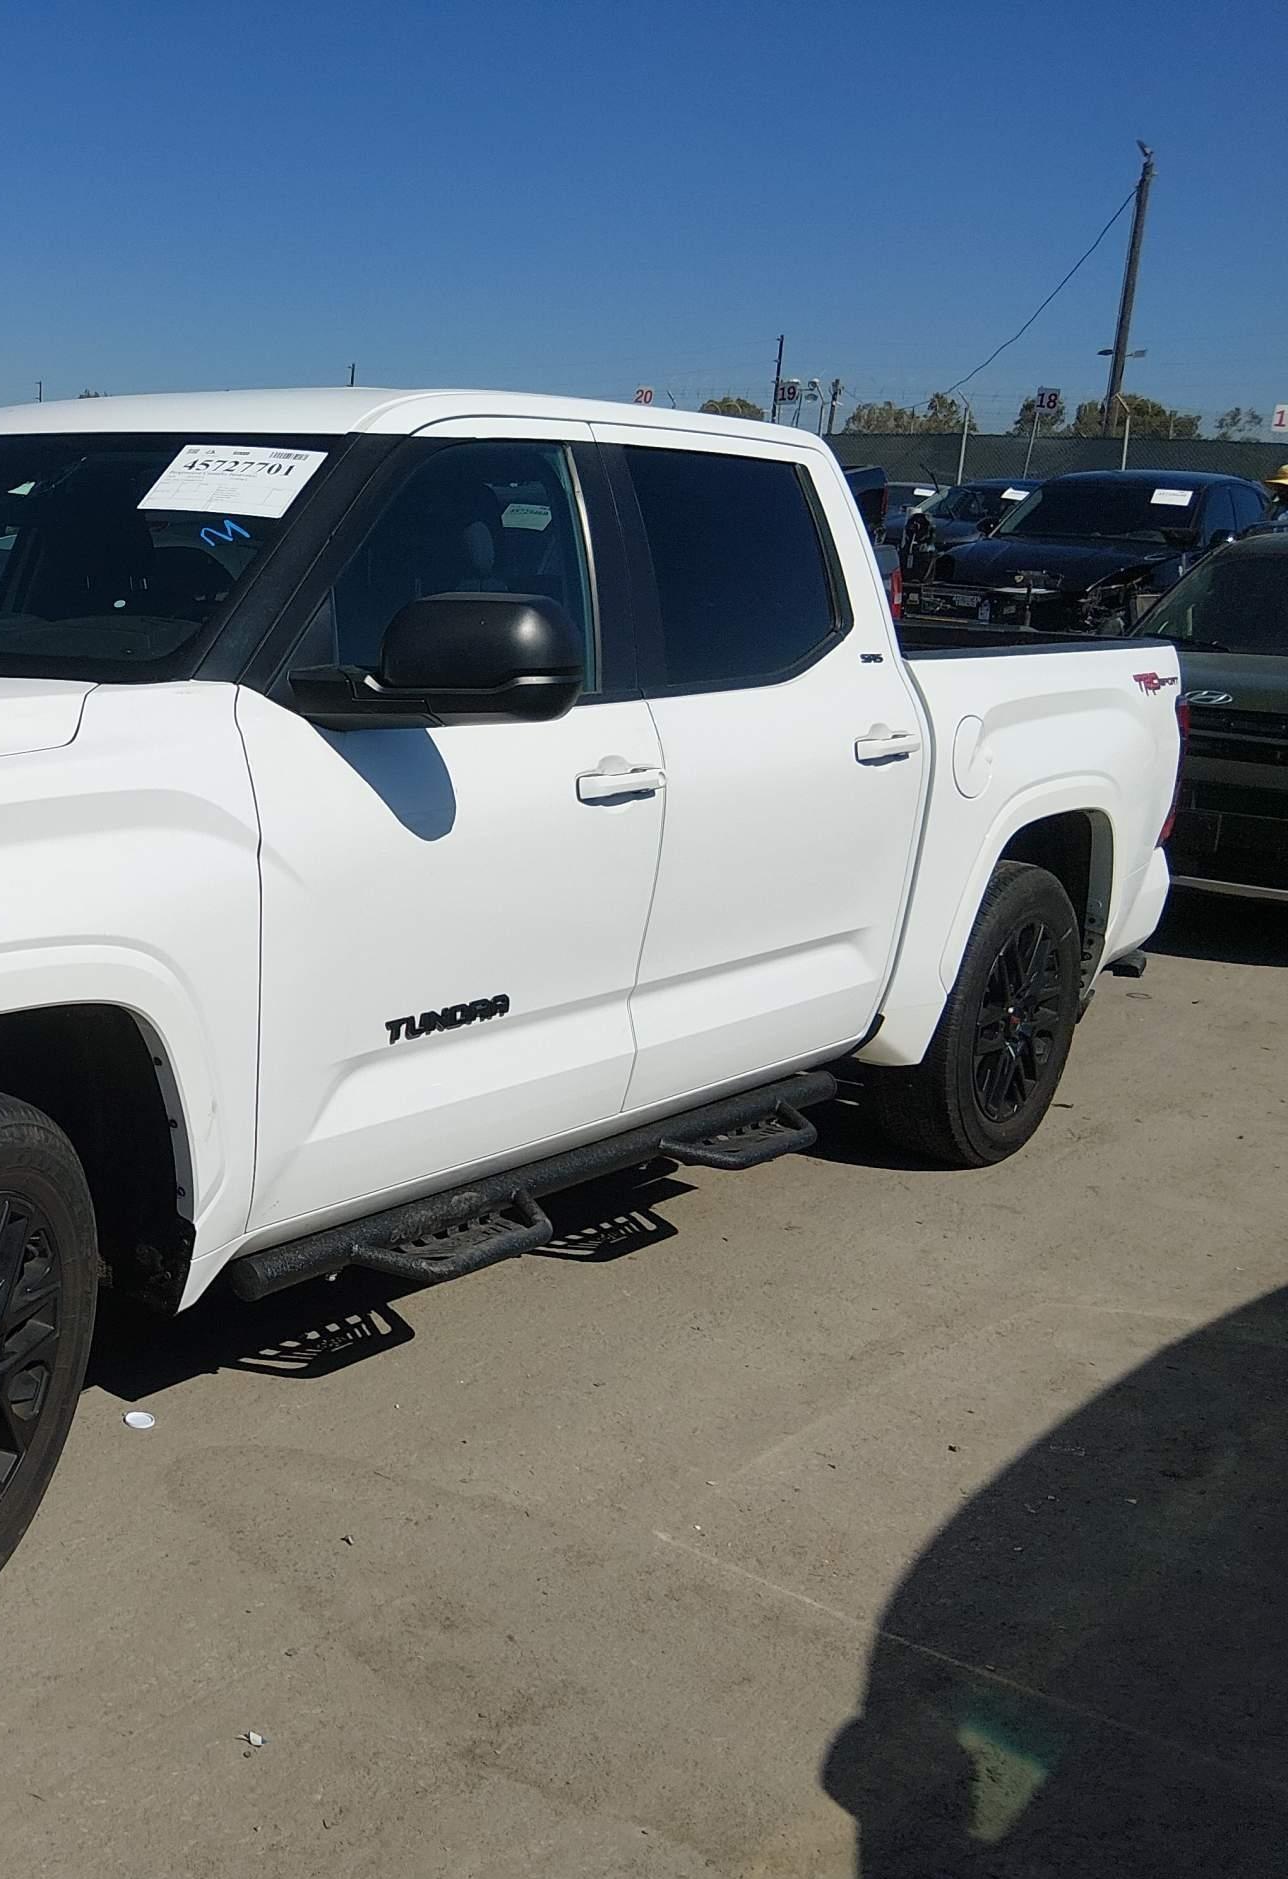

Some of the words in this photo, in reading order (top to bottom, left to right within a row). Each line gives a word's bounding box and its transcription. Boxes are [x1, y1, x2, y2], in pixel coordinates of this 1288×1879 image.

[634, 389, 653, 404] 20
[778, 385, 797, 401] 19
[1036, 392, 1058, 409] 18
[183, 458, 296, 477] 45727701
[1132, 672, 1161, 697] TRD
[385, 993, 510, 1045] TUNDRA
